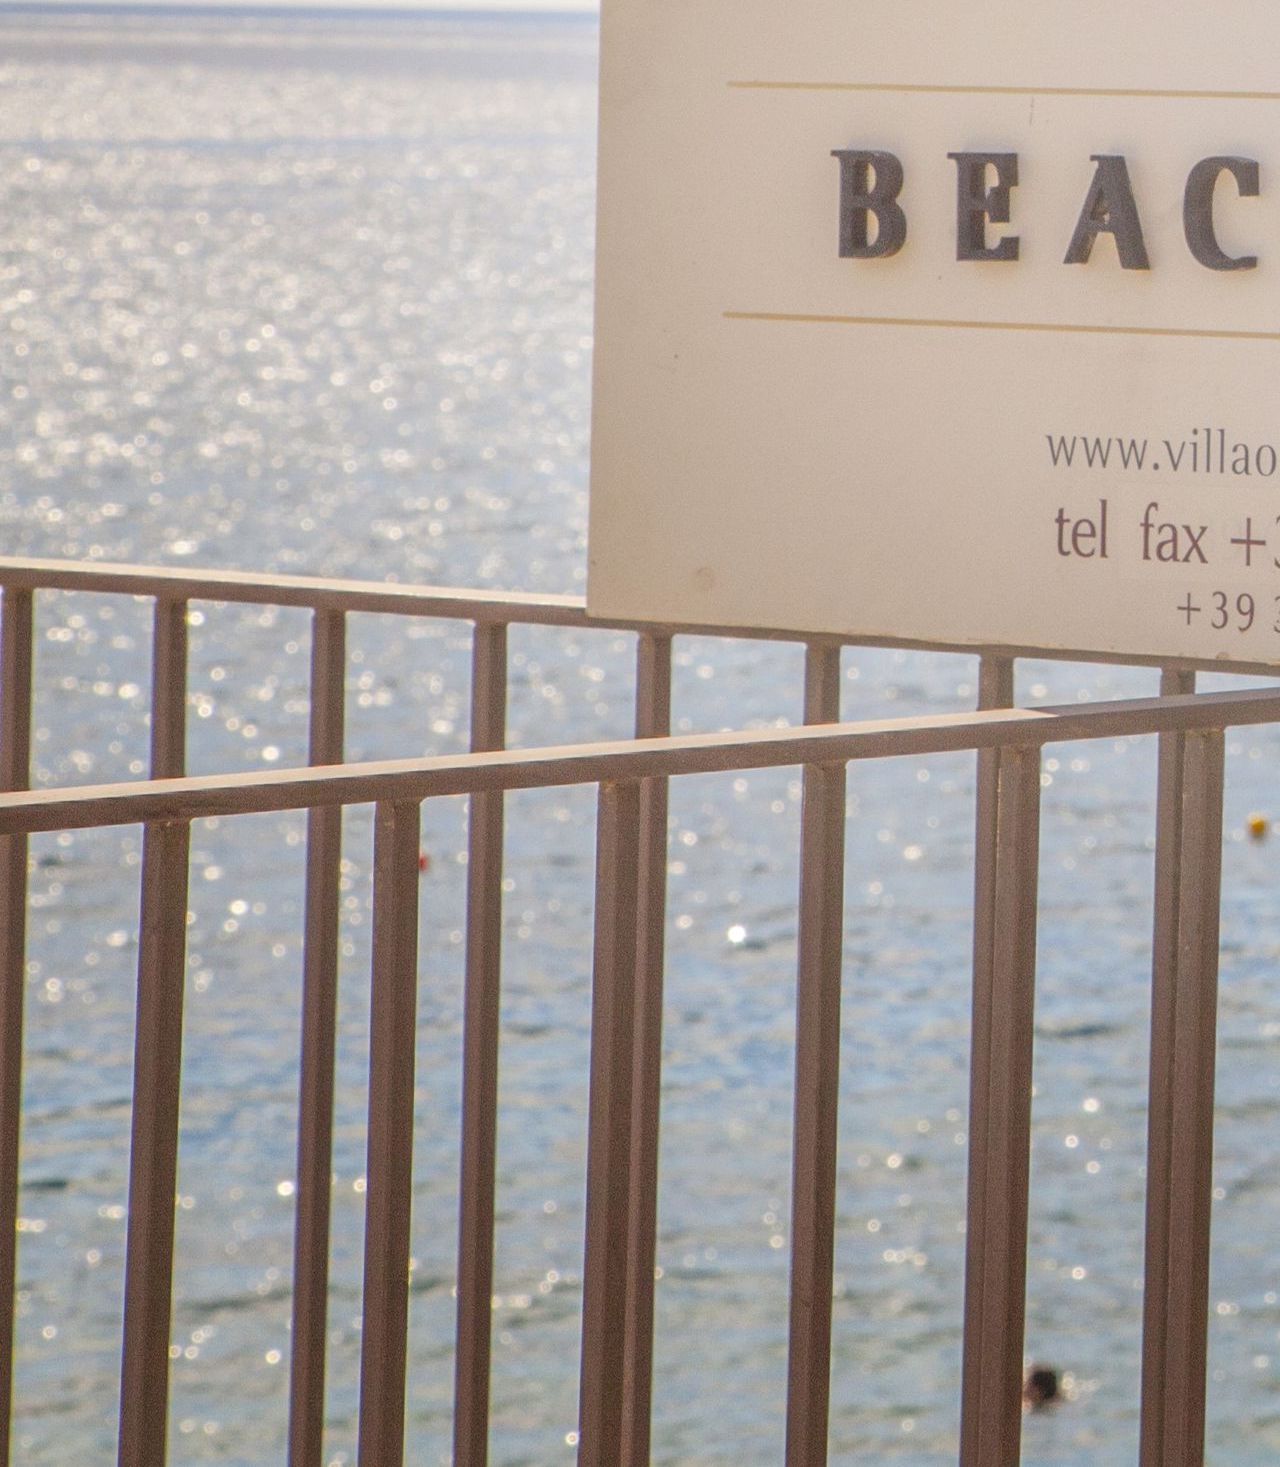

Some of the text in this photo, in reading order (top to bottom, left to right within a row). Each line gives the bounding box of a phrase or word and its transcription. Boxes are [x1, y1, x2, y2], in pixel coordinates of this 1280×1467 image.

[1054, 500, 1109, 561] tel
[1140, 501, 1210, 567] fax
[1176, 590, 1257, 634] +39
